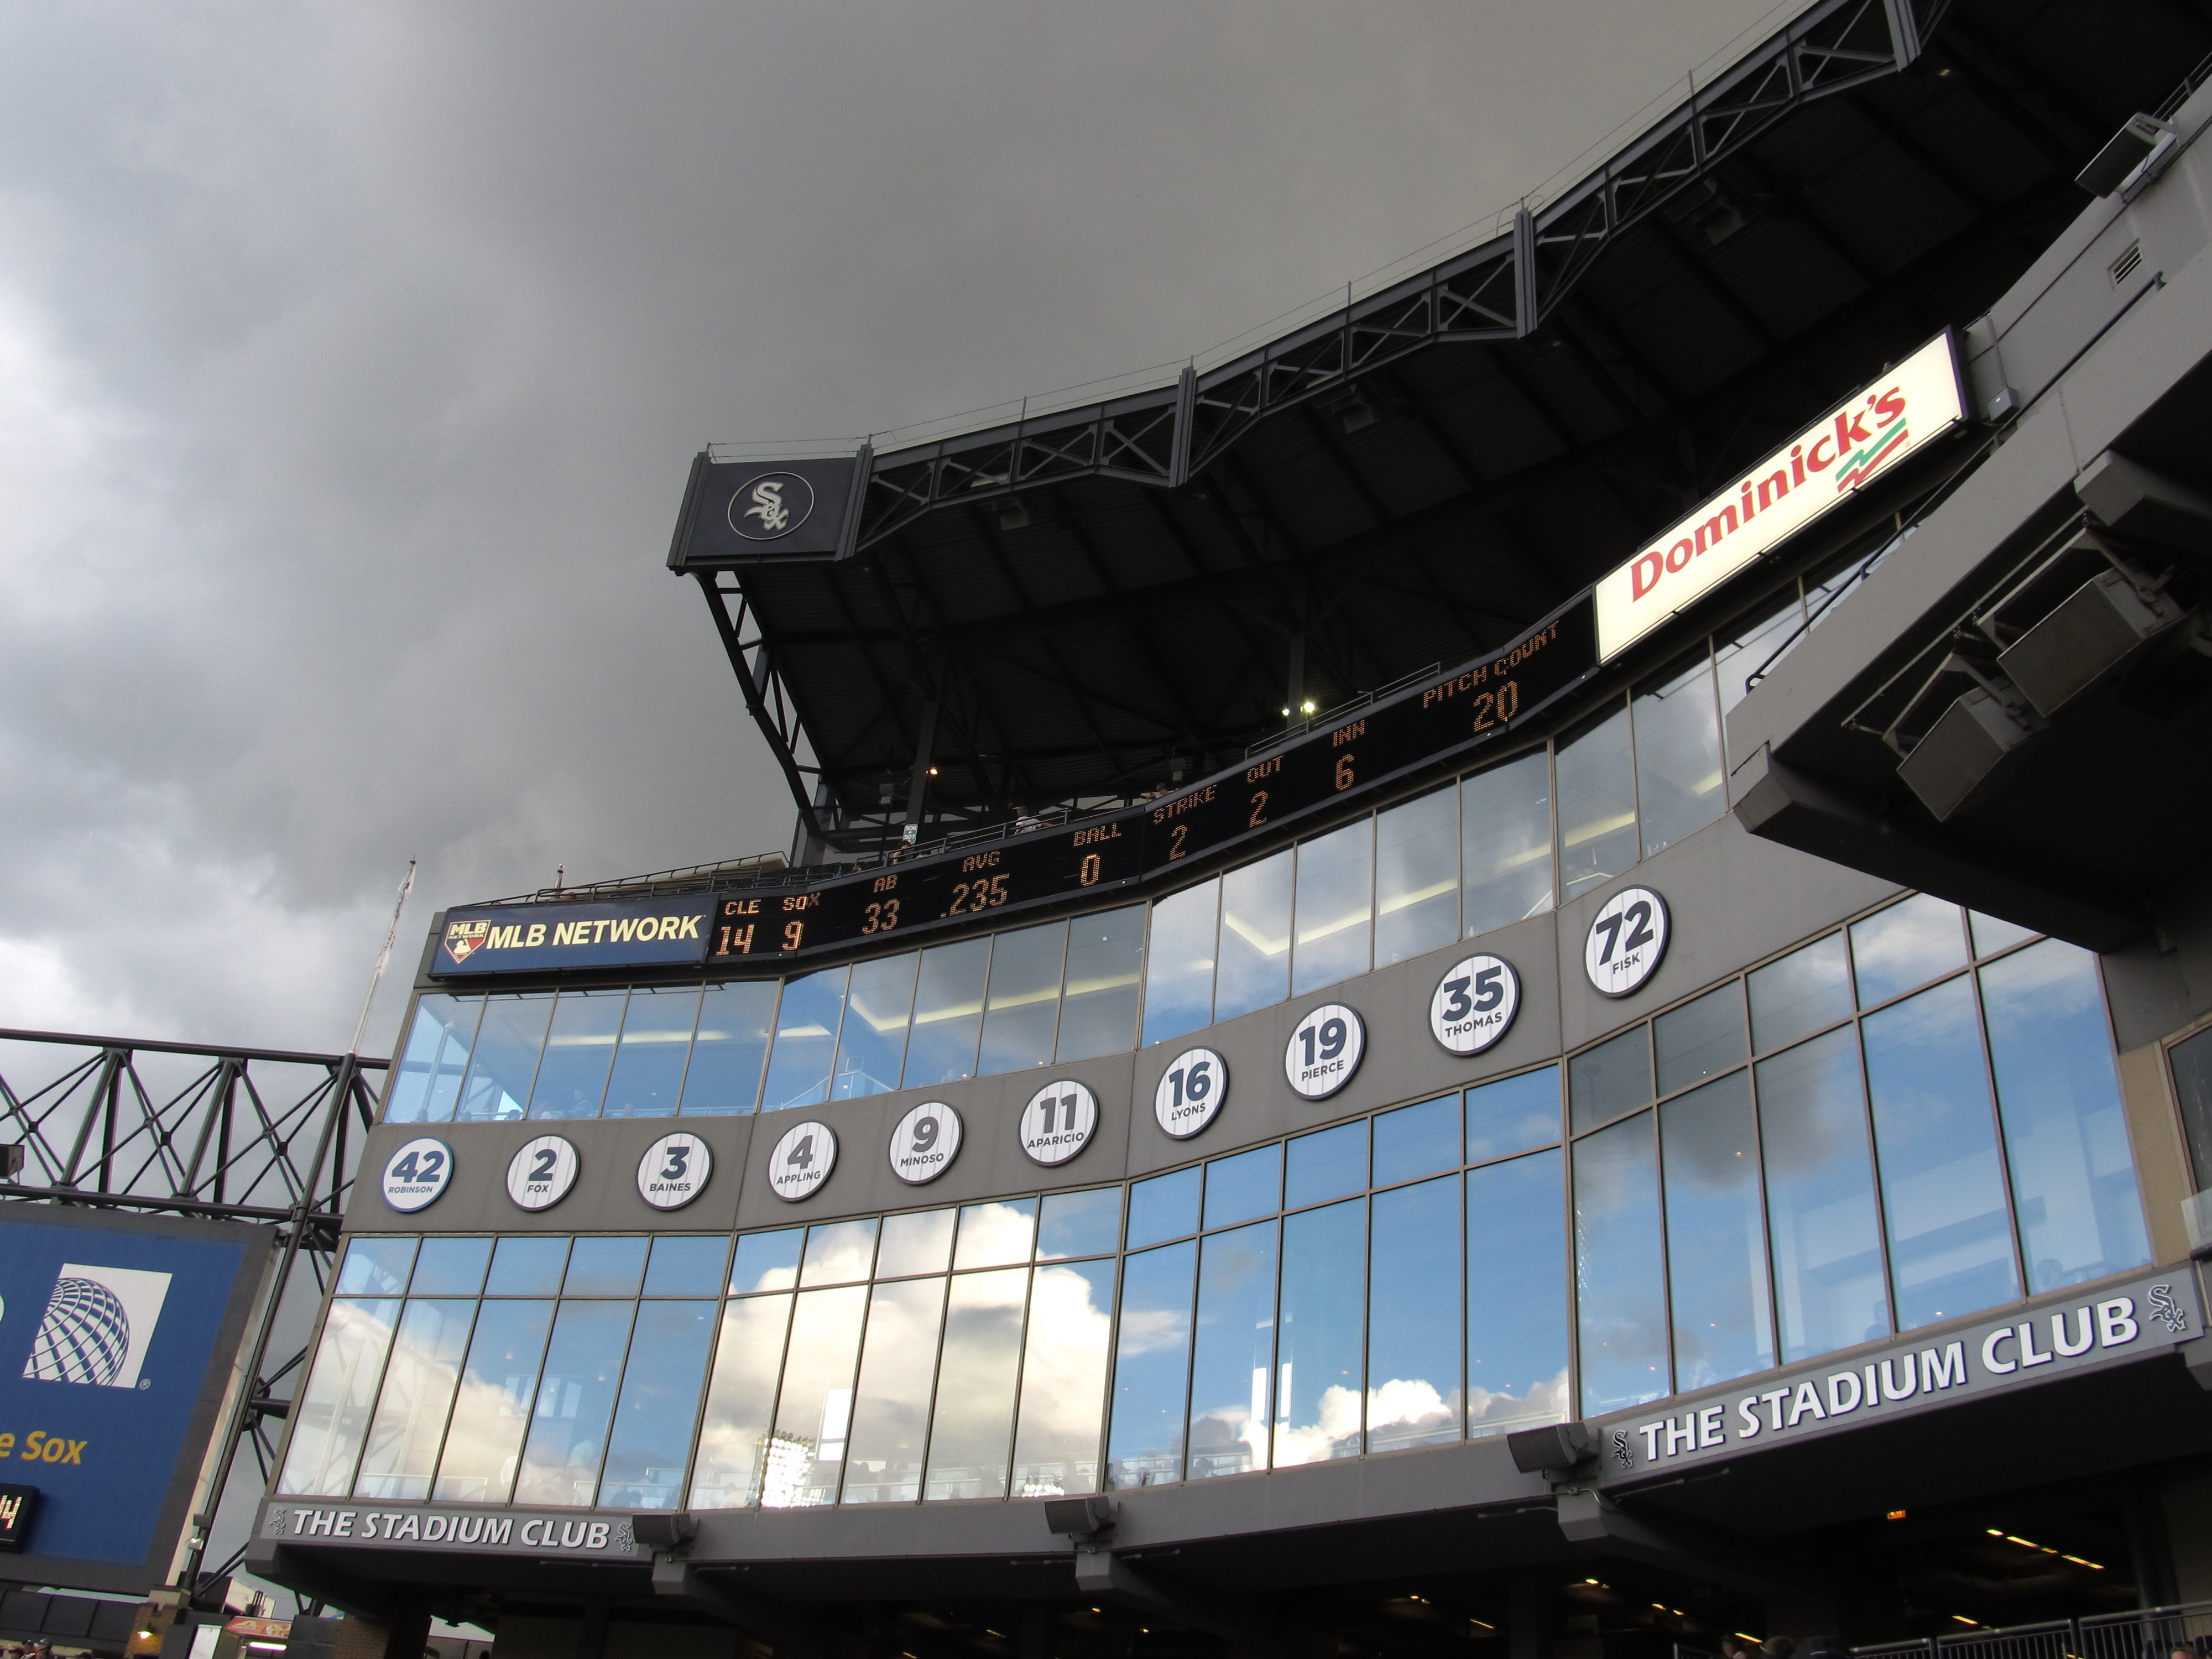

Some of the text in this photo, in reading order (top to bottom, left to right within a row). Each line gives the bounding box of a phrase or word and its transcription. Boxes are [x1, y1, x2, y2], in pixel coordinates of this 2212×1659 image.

[1630, 387, 1906, 603] Dominick's
[1423, 620, 1559, 709] PITCH COUNT
[1473, 680, 1519, 732] 20
[1333, 719, 1365, 747] INN
[1248, 755, 1283, 784] OUT
[1335, 753, 1354, 790] 6
[1154, 785, 1215, 825] STRIKE
[1249, 790, 1268, 827] 2
[1073, 823, 1122, 847] BALL
[1169, 825, 1187, 860] 2
[963, 851, 1000, 872] AVG
[1081, 853, 1100, 886] 0
[873, 874, 897, 893] AB
[941, 873, 1010, 918] .235
[724, 900, 760, 915] CLE
[782, 891, 821, 911] SOX
[862, 899, 900, 935] 33
[450, 922, 487, 935] MLB
[486, 915, 703, 950] MLB NETWORK
[716, 924, 754, 956] 14
[782, 920, 804, 951] 9
[1596, 900, 1653, 966] 72
[1613, 952, 1640, 975] FISK
[1442, 965, 1504, 1021] 35
[1444, 1012, 1503, 1037] THOMAS
[1299, 1018, 1347, 1066] 19
[1168, 1061, 1211, 1107] 16
[1301, 1060, 1344, 1082] PIERCE
[1040, 1093, 1078, 1134] 11
[1171, 1103, 1206, 1121] LYONS
[912, 1116, 939, 1152] 9
[1027, 1131, 1084, 1149] APARICIO
[392, 1151, 444, 1183] 42
[528, 1149, 557, 1181] 2
[660, 1146, 690, 1180] 3
[787, 1135, 813, 1169] 4
[900, 1152, 944, 1167] MINOSO
[388, 1185, 433, 1194] ROBINSON
[527, 1185, 549, 1193] FOX
[649, 1182, 691, 1192] BAINES
[776, 1171, 821, 1185] APPLING
[1639, 1405, 1726, 1462] THE
[1738, 1340, 1967, 1438] STADIUM
[1981, 1296, 2140, 1375] CLUB
[20, 1431, 88, 1464] Sox
[294, 1509, 357, 1537] THE
[361, 1512, 514, 1545] STADIUM
[520, 1519, 611, 1549] CLUB
